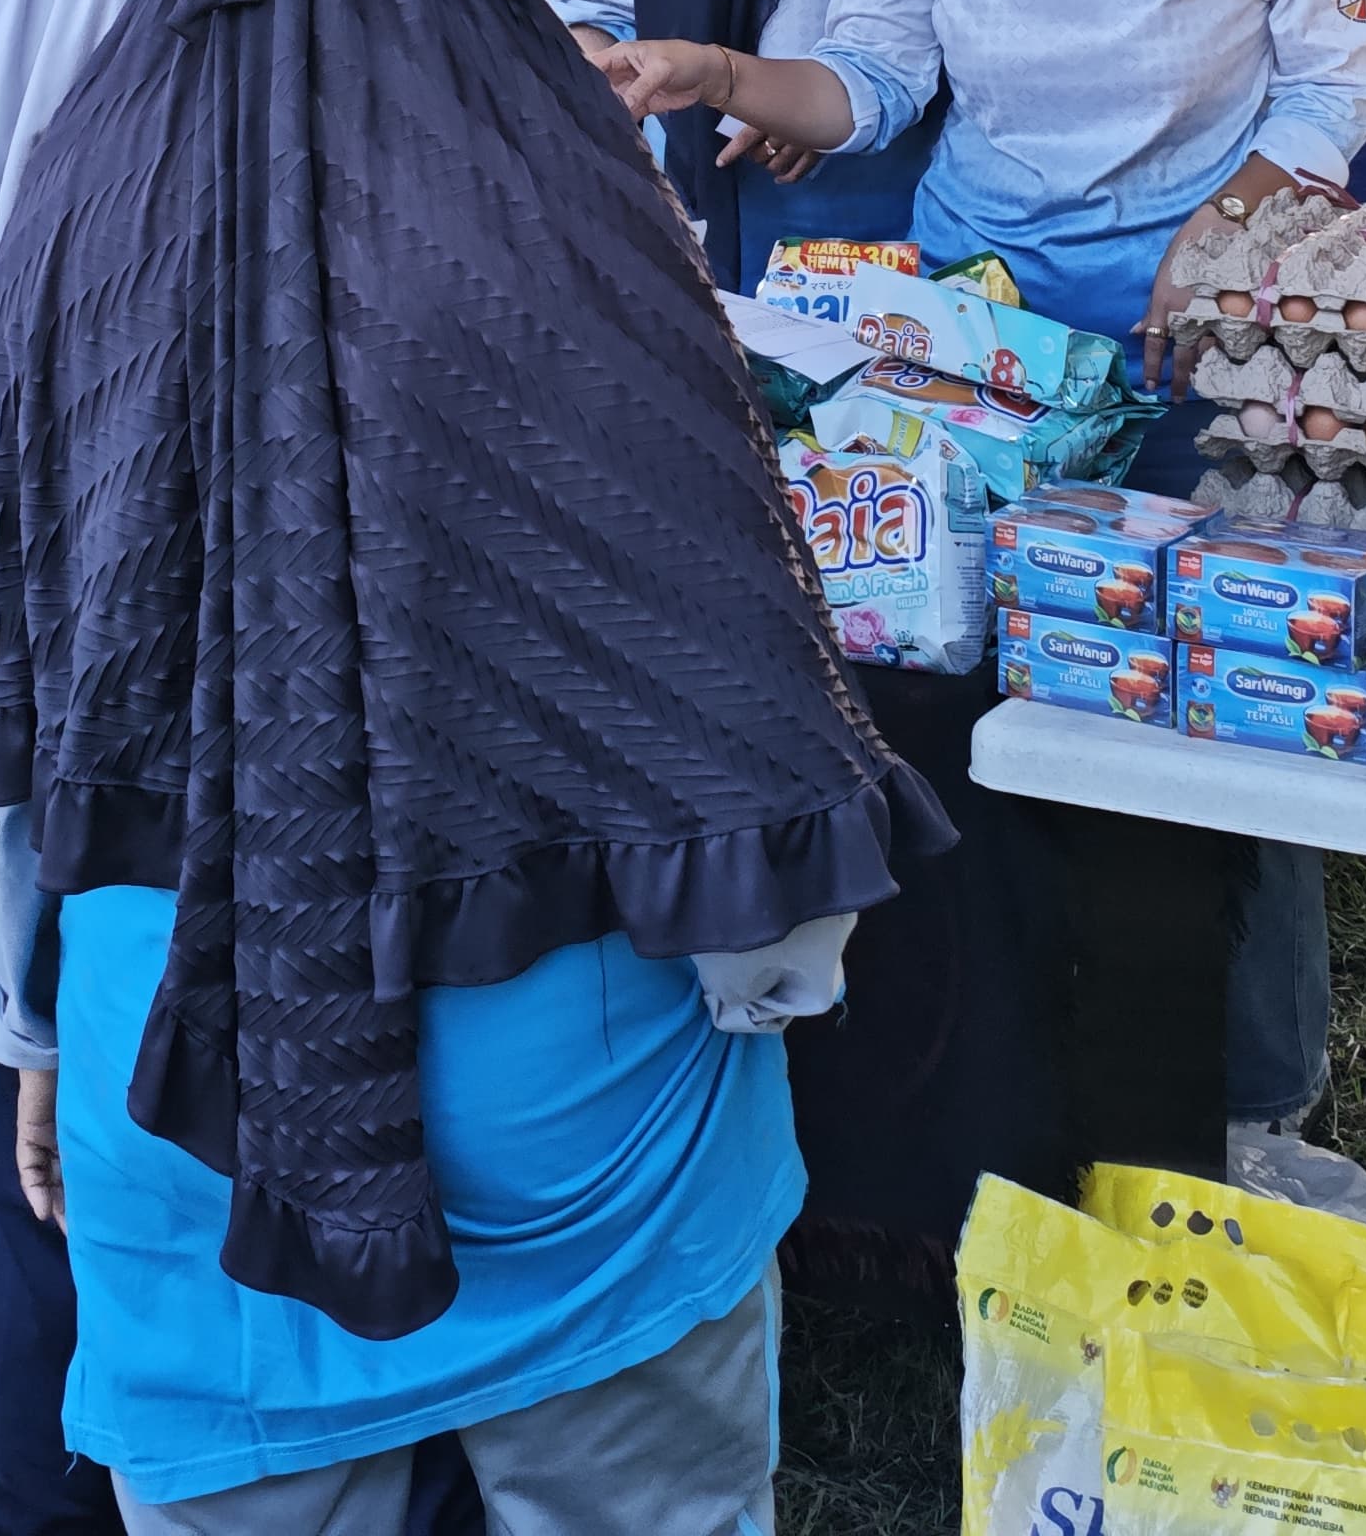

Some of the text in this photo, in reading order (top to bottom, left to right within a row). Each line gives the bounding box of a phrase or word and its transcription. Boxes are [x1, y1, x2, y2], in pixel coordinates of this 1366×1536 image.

[807, 255, 860, 271] HEMAT
[808, 243, 916, 272] HARGA 30%
[810, 280, 853, 290] ママレモン
[855, 315, 932, 363] Daia
[1035, 548, 1097, 574] SariWangi
[852, 576, 870, 598] &
[871, 572, 928, 596] Fresh
[1044, 582, 1087, 599] TEH ASLI
[1221, 579, 1290, 605] SariWangi
[1231, 615, 1278, 631] TEH ASLI
[1049, 638, 1112, 664] SariWangi
[1058, 672, 1101, 689] TEH ASLI
[1236, 675, 1307, 700] SariWangi
[1246, 710, 1294, 726] TEH ASLI
[1257, 703, 1283, 714] 100%
[1011, 1311, 1047, 1331] PANGAN
[1014, 1302, 1045, 1320] BADAN
[1009, 1319, 1051, 1345] NASIONAL
[1246, 1479, 1314, 1502] KEMENTERIAN
[1244, 1492, 1322, 1516] BIDANG PANGAN
[1242, 1504, 1345, 1534] REPUBLIK INDONESIA
